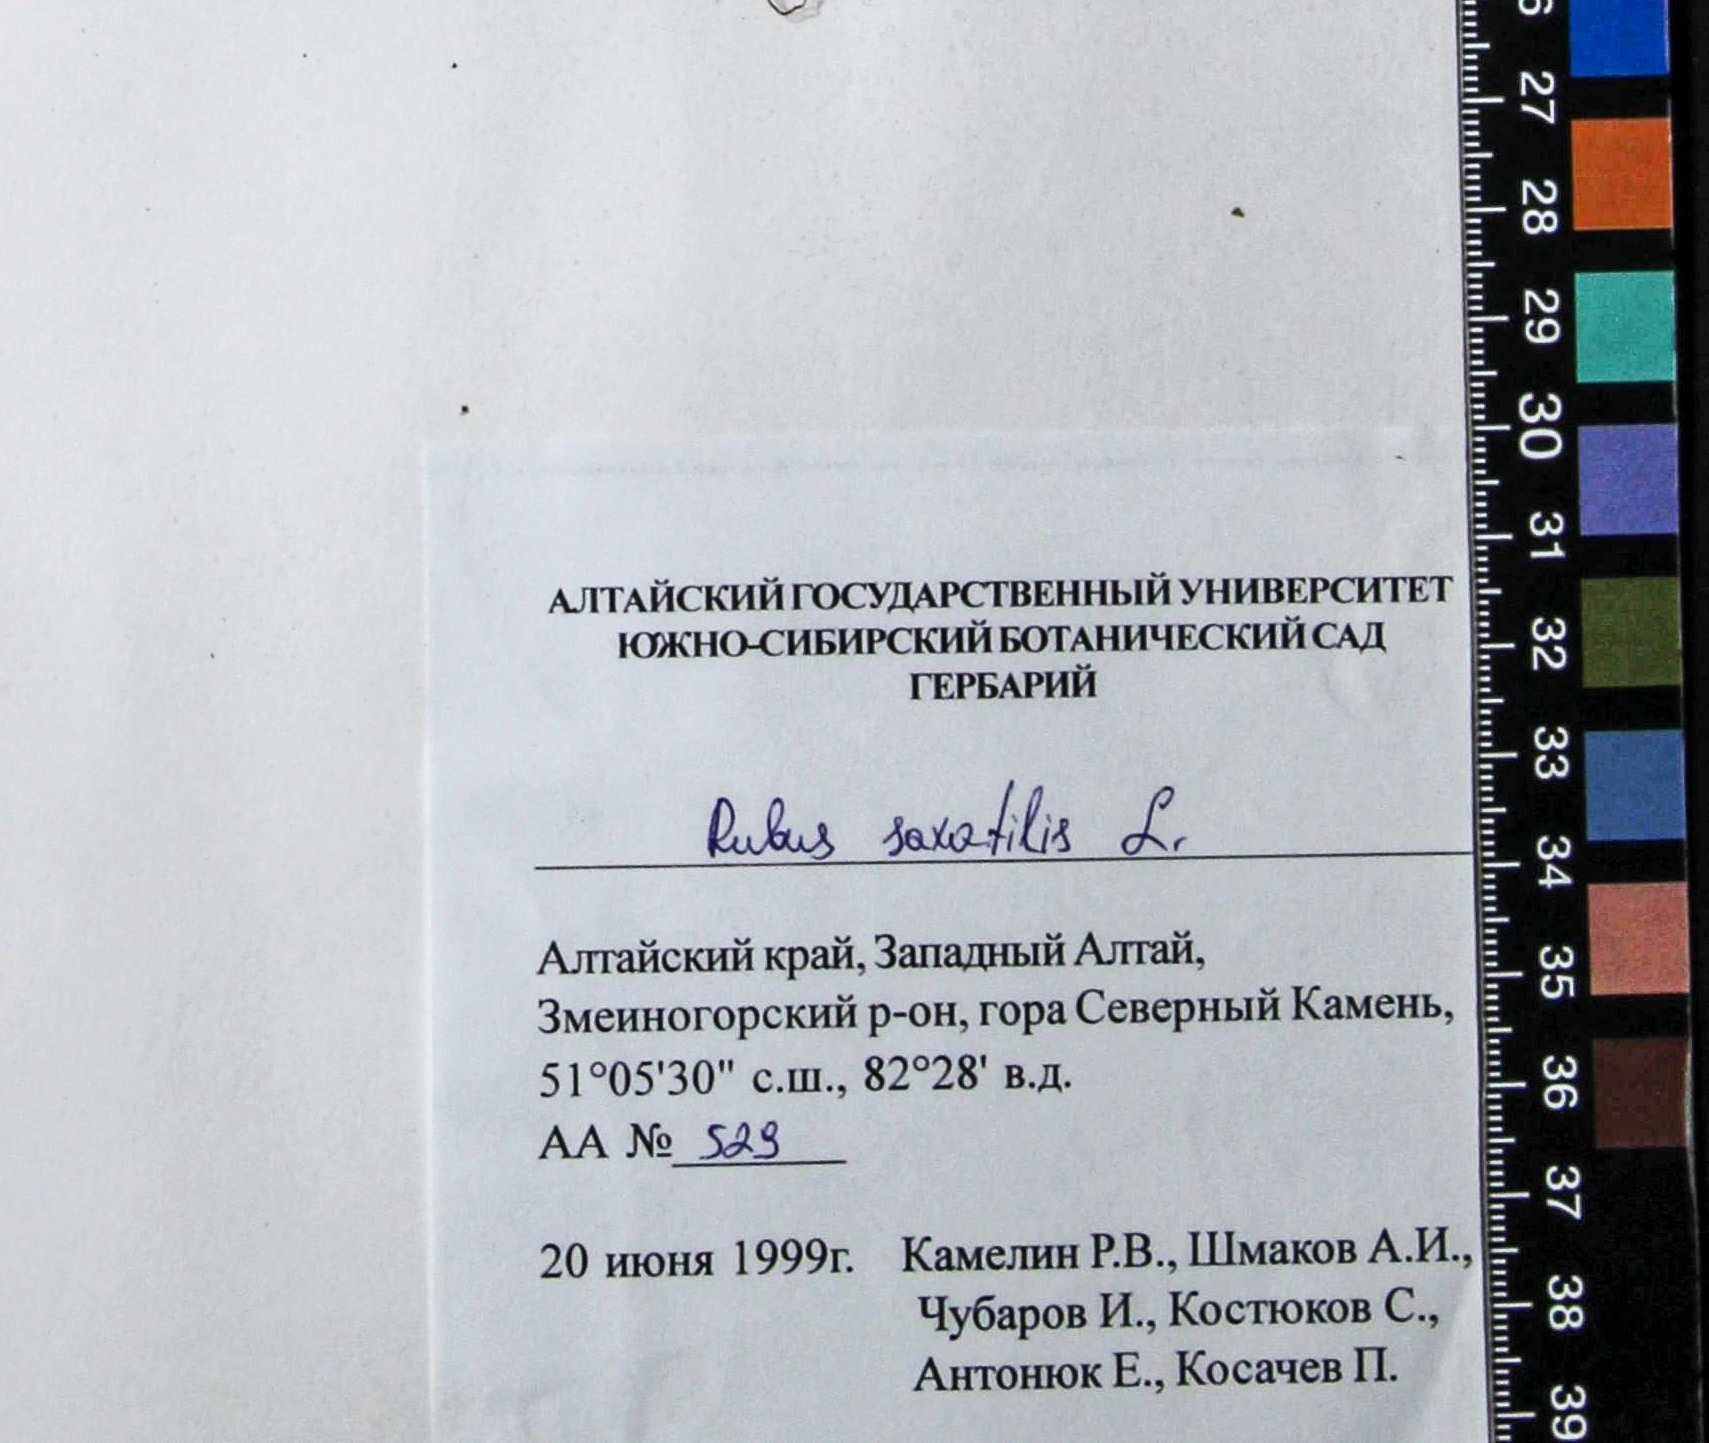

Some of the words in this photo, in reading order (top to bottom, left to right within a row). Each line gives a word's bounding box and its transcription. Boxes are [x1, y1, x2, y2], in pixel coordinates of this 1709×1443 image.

[1521, 72, 1554, 123] 27
[1523, 180, 1557, 234] 28
[1525, 290, 1560, 343] 29
[1519, 394, 1562, 459] 30
[1530, 512, 1564, 557] 31
[548, 576, 784, 614] АЛТАЙСКИЙ
[792, 572, 1171, 614] ГОСУДАРСТВЕННЫЙ
[1178, 575, 1454, 605] УНИВЕРСИТЕТ
[618, 619, 993, 659] ЮЖНО-СИБИРСКИЙ
[999, 616, 1306, 653] БОТАНИЧЕСКИЙ
[1312, 622, 1387, 654] САД
[1532, 618, 1566, 670] 32
[910, 663, 1097, 700] ГЕРБАРИЙ
[1534, 727, 1569, 779] 33
[707, 797, 835, 860] Rubus
[882, 779, 1071, 857] saxatilis
[1538, 836, 1571, 888] 34
[536, 937, 755, 975] Алтайский
[764, 935, 866, 980] край,
[874, 932, 1066, 973] Западный
[1073, 929, 1205, 971] Алтай,
[1540, 946, 1574, 998] 35
[538, 994, 857, 1040] Змеиногорский
[868, 1002, 969, 1038] р-он,
[979, 1000, 1068, 1036] гора
[1076, 987, 1281, 1031] Северный
[1291, 985, 1454, 1025] Камень,
[752, 1068, 847, 1099] с.ш.,
[1004, 1064, 1071, 1094] в.д.
[1543, 1056, 1577, 1108] 36
[699, 1120, 780, 1160] 529
[1546, 1166, 1580, 1219] 37
[540, 1242, 588, 1279] 20
[605, 1251, 714, 1278] июня
[735, 1238, 854, 1276] 1999г.
[901, 1236, 1080, 1272] Камелин
[1090, 1232, 1177, 1274] Р.В.,
[1188, 1231, 1357, 1267] Шмаков
[1367, 1226, 1472, 1269] А.И.,
[917, 1294, 1087, 1336] Чубаров
[1100, 1292, 1156, 1334] И.,
[1168, 1290, 1372, 1327] Костюков
[1385, 1286, 1439, 1329] С.,
[1548, 1275, 1583, 1329] 38
[912, 1356, 1103, 1392] Антонюк
[1113, 1351, 1165, 1394] Е.,
[1176, 1350, 1343, 1387] Косачев
[1354, 1346, 1398, 1383] П.
[1551, 1386, 1586, 1439] 39
